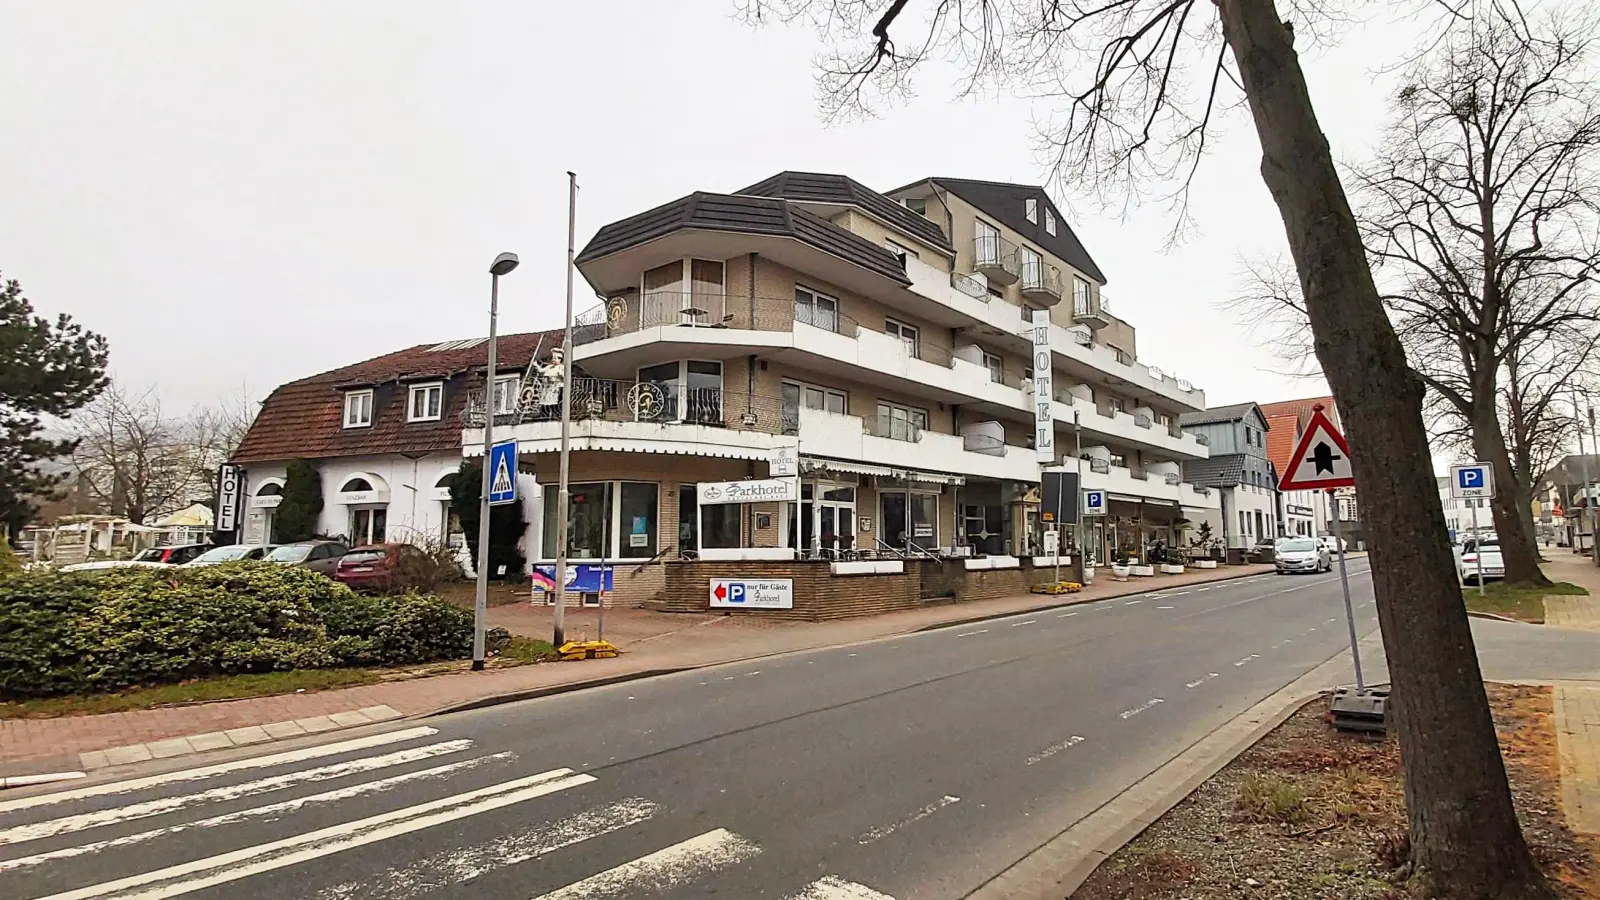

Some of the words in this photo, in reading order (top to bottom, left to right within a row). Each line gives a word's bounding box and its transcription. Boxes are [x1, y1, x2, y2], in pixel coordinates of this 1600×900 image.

[1034, 326, 1051, 447] HOTEL
[1464, 471, 1477, 486] P
[725, 482, 788, 497] Parkhotel
[221, 468, 236, 529] HOTEL
[1090, 494, 1098, 506] P
[731, 586, 743, 600] P
